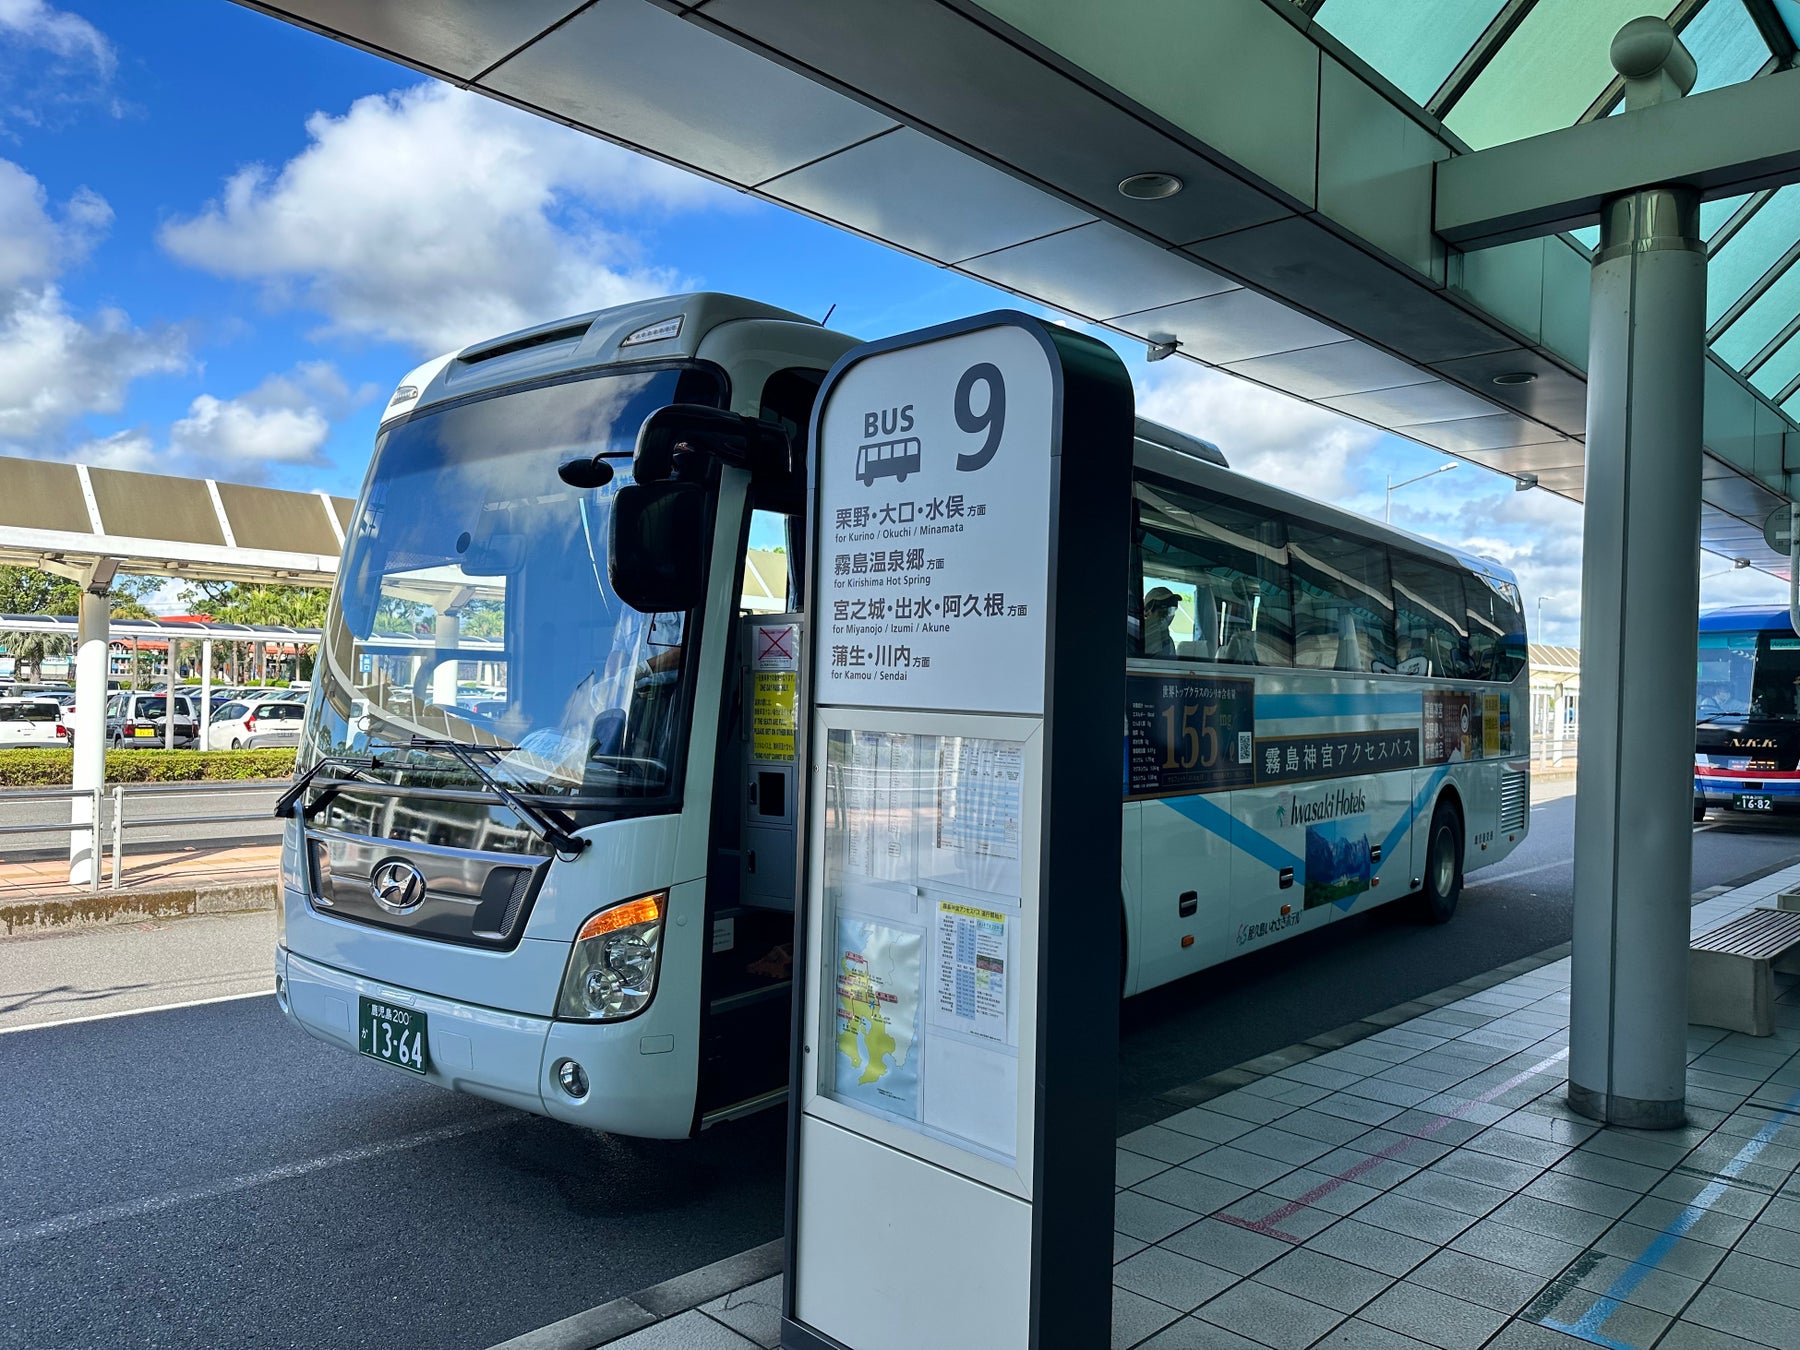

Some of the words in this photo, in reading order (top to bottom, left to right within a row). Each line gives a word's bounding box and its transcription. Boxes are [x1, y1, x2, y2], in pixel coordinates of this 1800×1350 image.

[864, 405, 914, 439] BUS
[954, 362, 1006, 472] 9
[835, 533, 846, 543] for
[848, 532, 875, 542] Kurino
[882, 527, 911, 539] Okuchi
[919, 523, 964, 536] Minamata
[834, 579, 845, 588] for
[847, 577, 884, 588] Kirishima
[886, 576, 901, 586] Hot
[903, 574, 931, 587] Spring
[832, 624, 844, 634] for
[845, 623, 883, 635] Miyanojo
[890, 622, 914, 633] Izumi
[921, 622, 950, 633] Akune
[831, 670, 843, 679] for
[844, 670, 872, 680] Kamou
[879, 670, 908, 681] Sendai
[1162, 704, 1218, 769] 155
[1265, 739, 1413, 774] 霧島神宮アクセスバス
[1290, 793, 1334, 825] Iwasaki
[1335, 788, 1366, 818] Hotels
